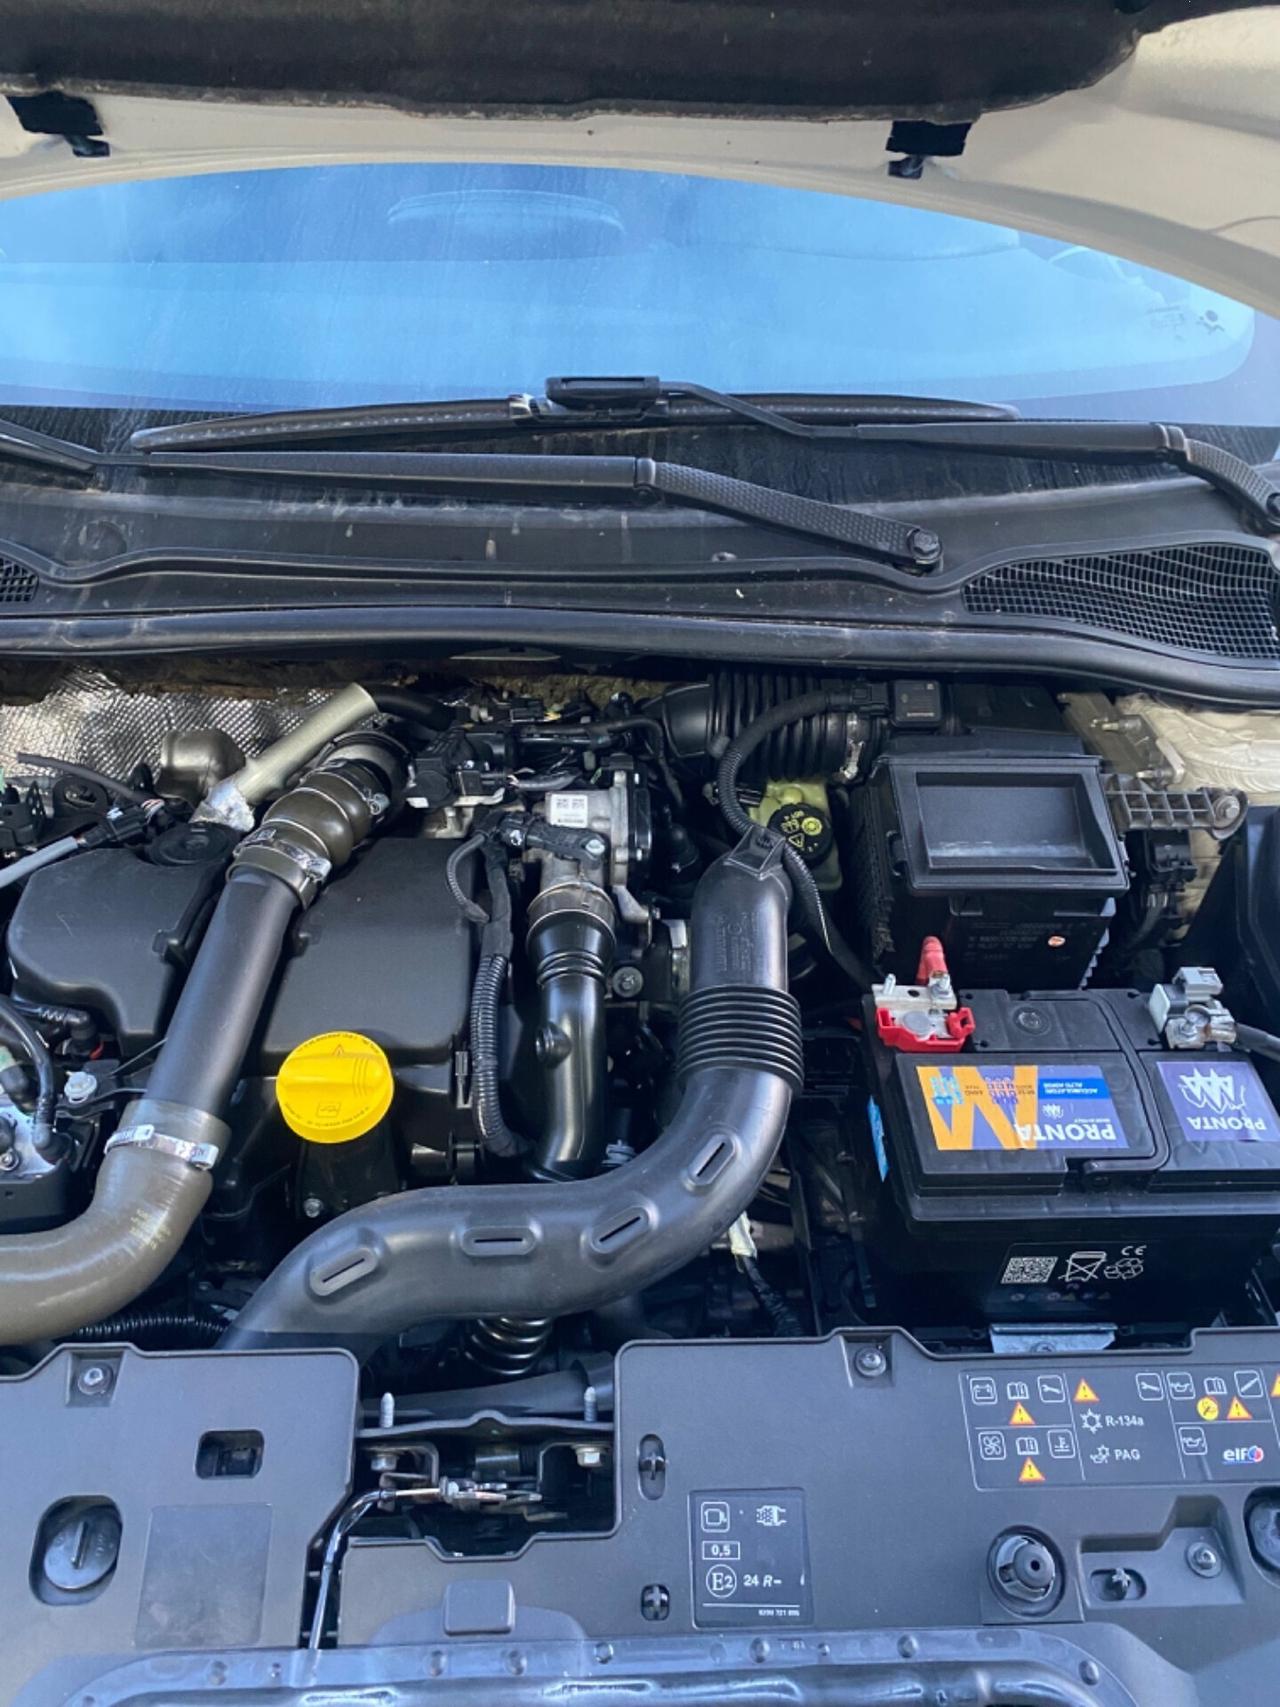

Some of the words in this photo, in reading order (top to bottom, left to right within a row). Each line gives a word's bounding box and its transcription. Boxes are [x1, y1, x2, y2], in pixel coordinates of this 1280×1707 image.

[1186, 1117, 1267, 1130] PRONTA
[1014, 1124, 1116, 1140] PRONTA
[1105, 1415, 1145, 1427] R-134a
[1114, 1449, 1141, 1461] PAG
[712, 1572, 734, 1591] E2
[743, 1574, 759, 1587] 24
